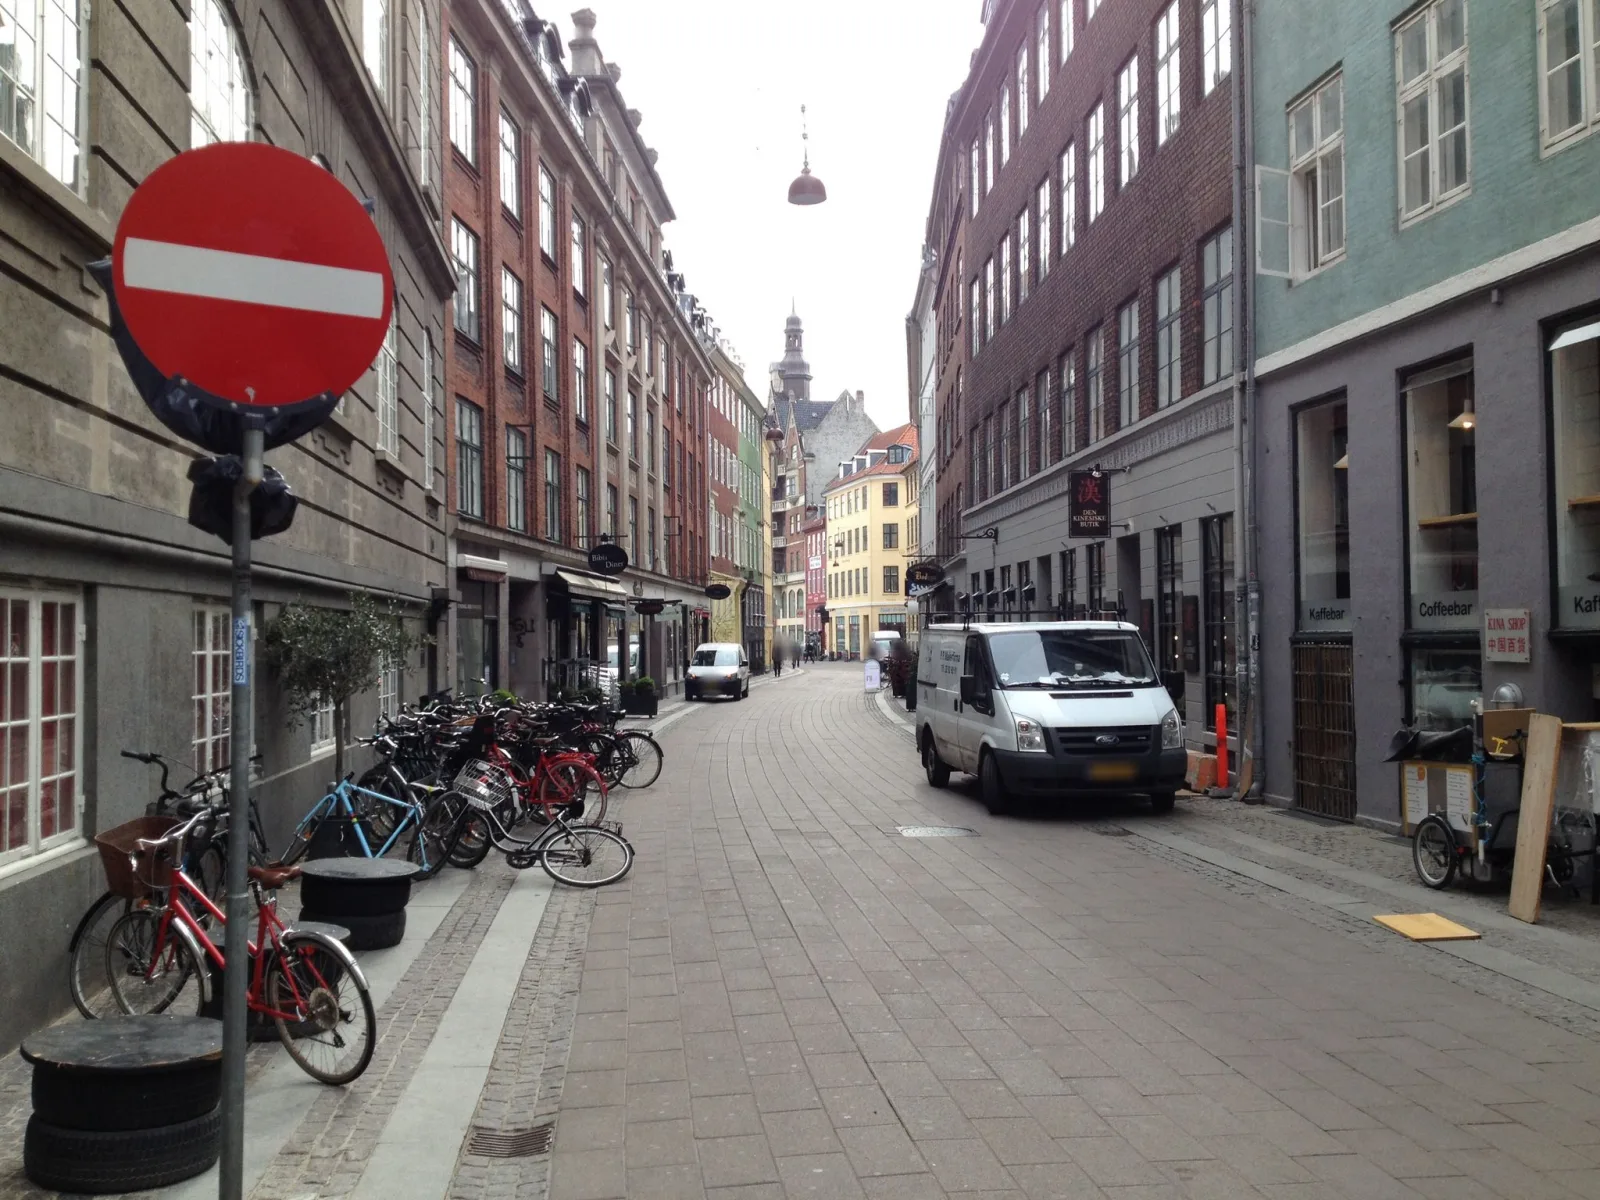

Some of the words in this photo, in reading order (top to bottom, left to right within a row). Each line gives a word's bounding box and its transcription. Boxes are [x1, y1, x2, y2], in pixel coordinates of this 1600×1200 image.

[605, 561, 624, 569] Diner
[1309, 607, 1345, 621] Kaffebar
[1419, 601, 1473, 617] Coffeebar
[1487, 617, 1505, 630] KINA
[1508, 617, 1526, 630] SHOP
